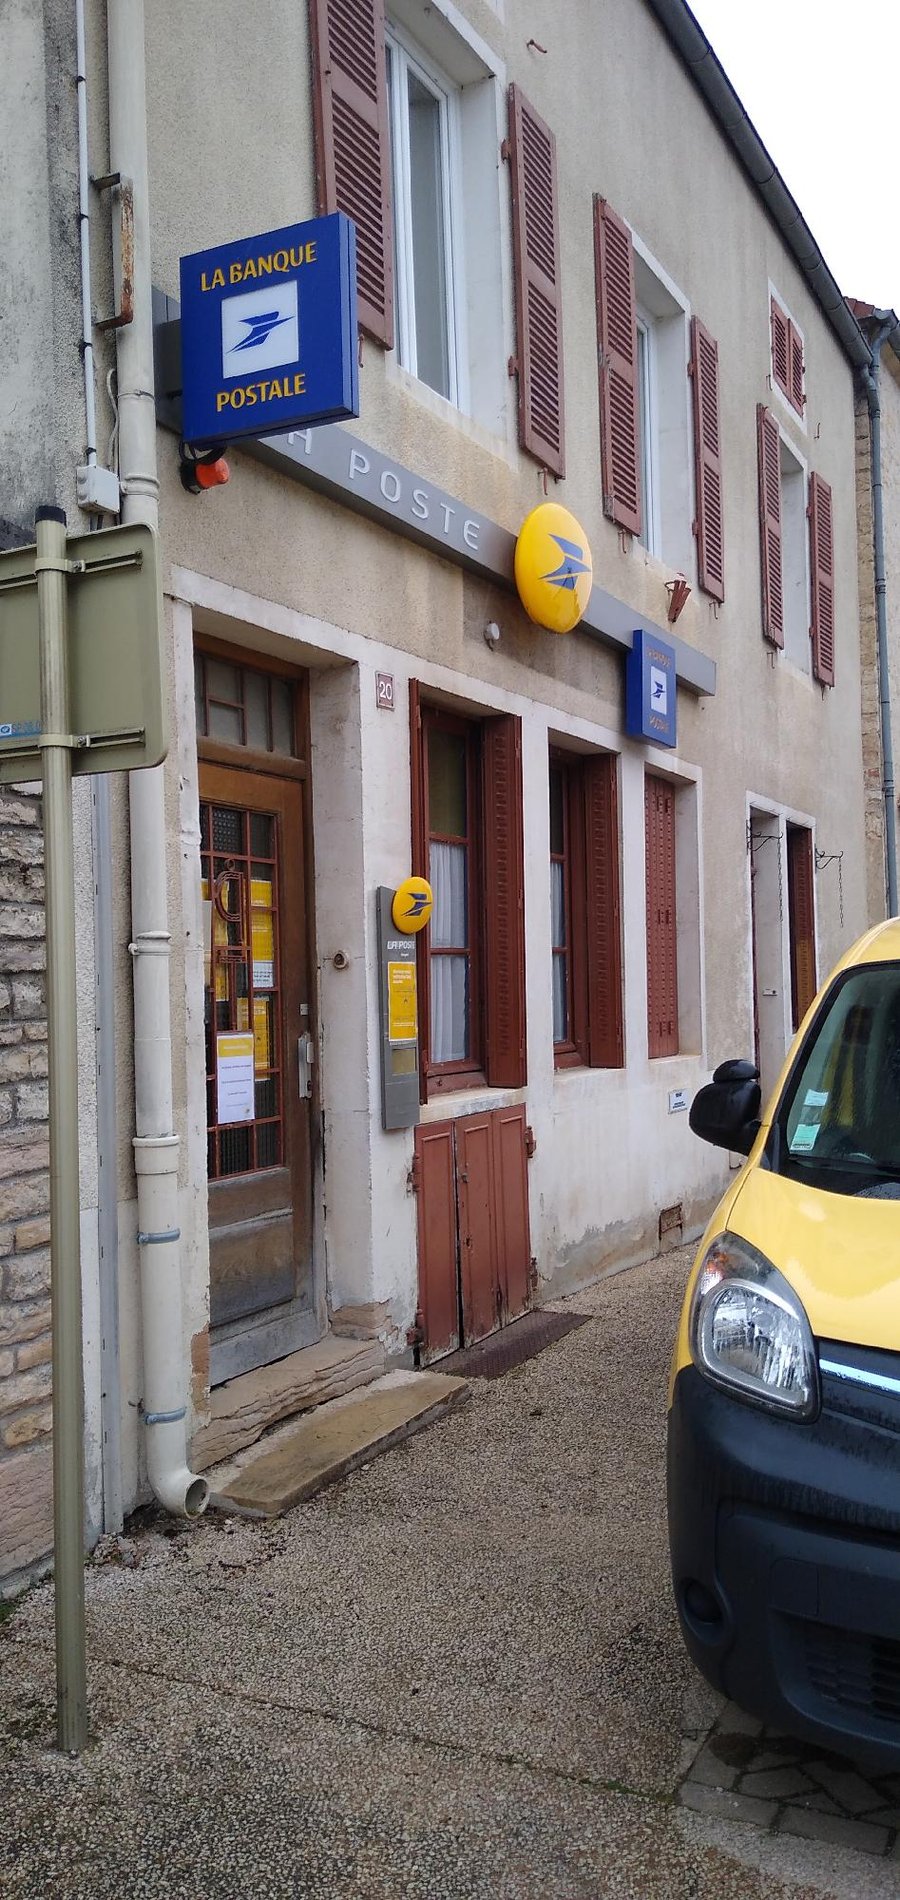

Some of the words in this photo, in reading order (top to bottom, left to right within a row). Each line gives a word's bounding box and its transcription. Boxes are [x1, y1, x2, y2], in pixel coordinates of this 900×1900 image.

[200, 267, 225, 292] LA
[229, 241, 318, 283] BANQUE
[216, 373, 307, 412] POSTALE
[287, 428, 313, 455] A
[349, 449, 481, 550] POSTE
[379, 680, 393, 700] 20
